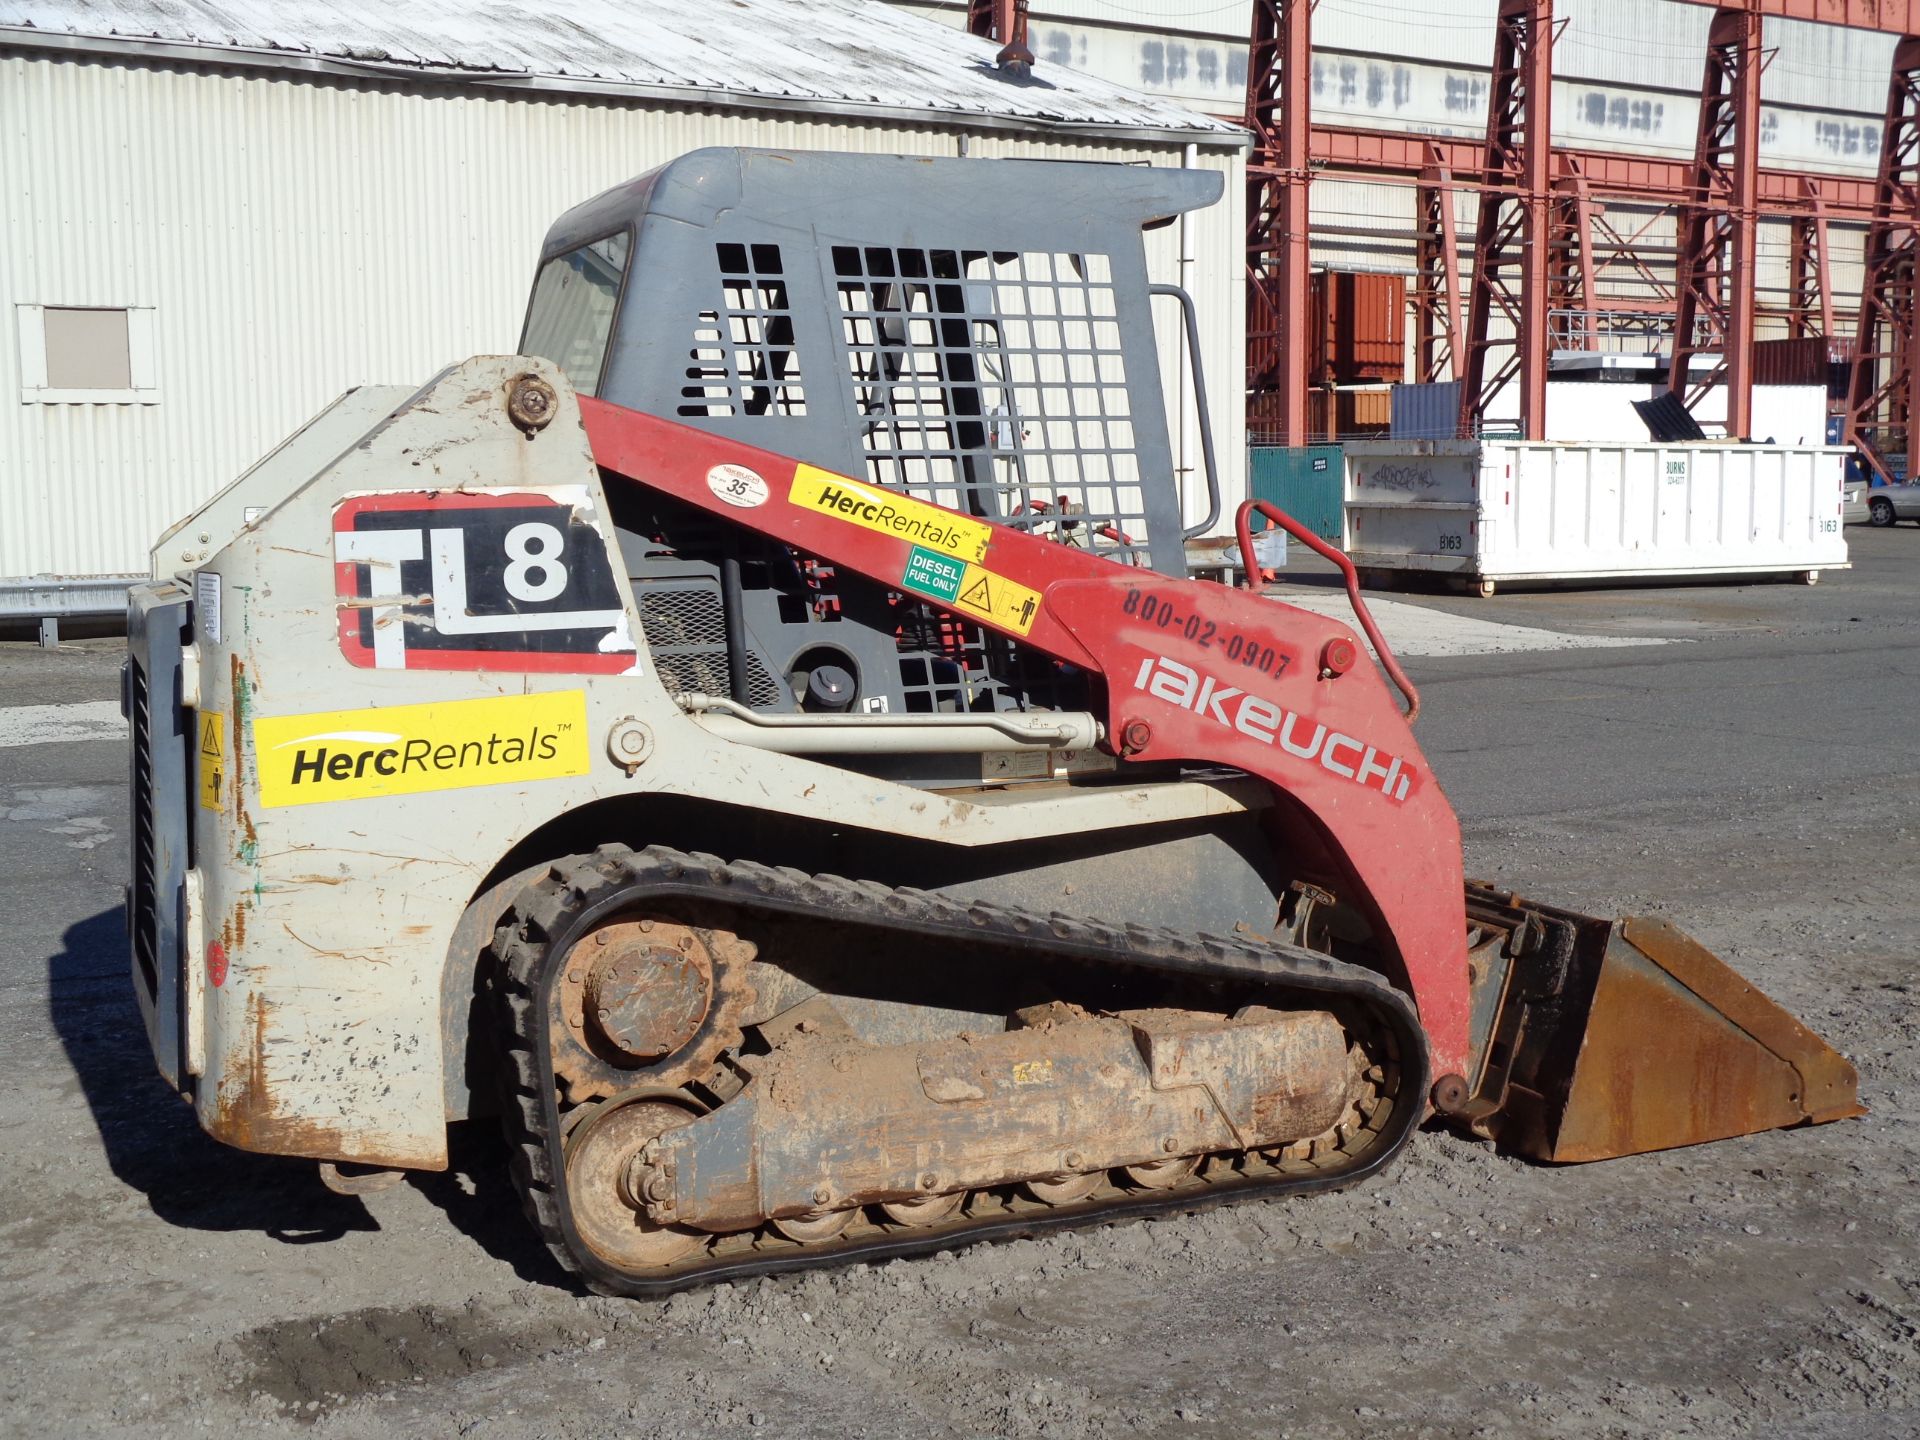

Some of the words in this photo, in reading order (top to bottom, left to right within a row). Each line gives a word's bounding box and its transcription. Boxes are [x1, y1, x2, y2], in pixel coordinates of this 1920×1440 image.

[727, 478, 749, 495] 35
[1440, 534, 1462, 550] B163
[911, 554, 959, 581] DIESEL
[907, 568, 931, 585] FUEL
[931, 578, 956, 593] ONLY
[1123, 587, 1291, 679] 800-02-0907
